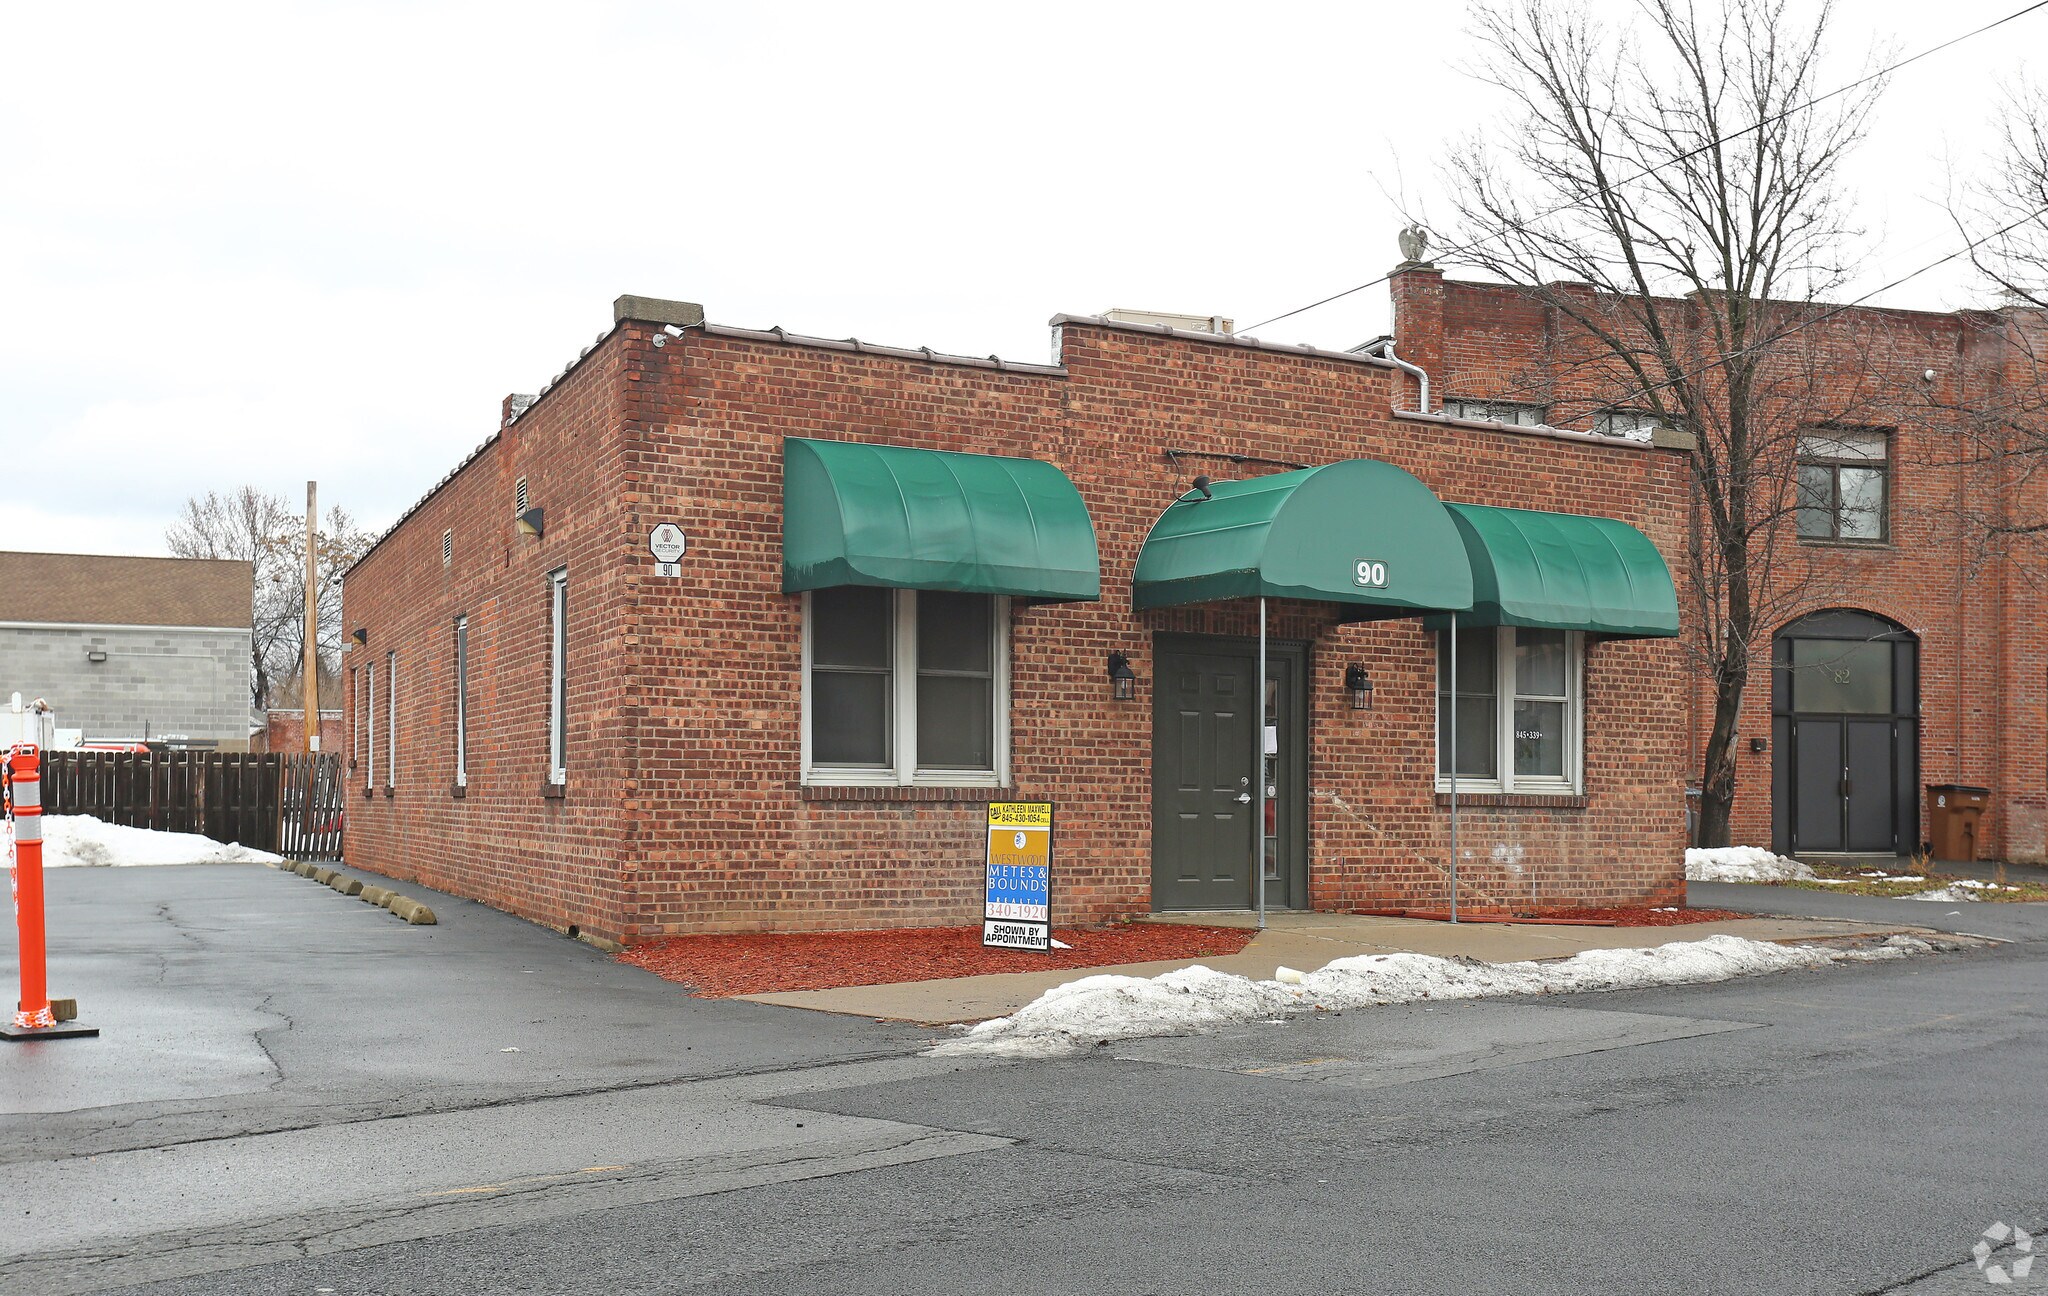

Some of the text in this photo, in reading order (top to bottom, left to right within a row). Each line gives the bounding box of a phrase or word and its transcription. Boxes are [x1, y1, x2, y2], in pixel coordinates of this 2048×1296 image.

[663, 563, 673, 577] 90
[1357, 561, 1385, 585] 90
[1834, 669, 1850, 684] 82
[990, 804, 1050, 818] CALL KATHLEEN MAXWELL
[1001, 813, 1041, 823] 845-430-1054
[991, 853, 1047, 866] WESTWOOD
[989, 865, 1047, 879] METES &
[989, 877, 1047, 892] BOUNDS
[996, 896, 1039, 905] REALTY
[987, 903, 1047, 919] 340-1920
[993, 924, 1040, 936] SHOWN BY
[985, 933, 1048, 947] APPOINTMENT
